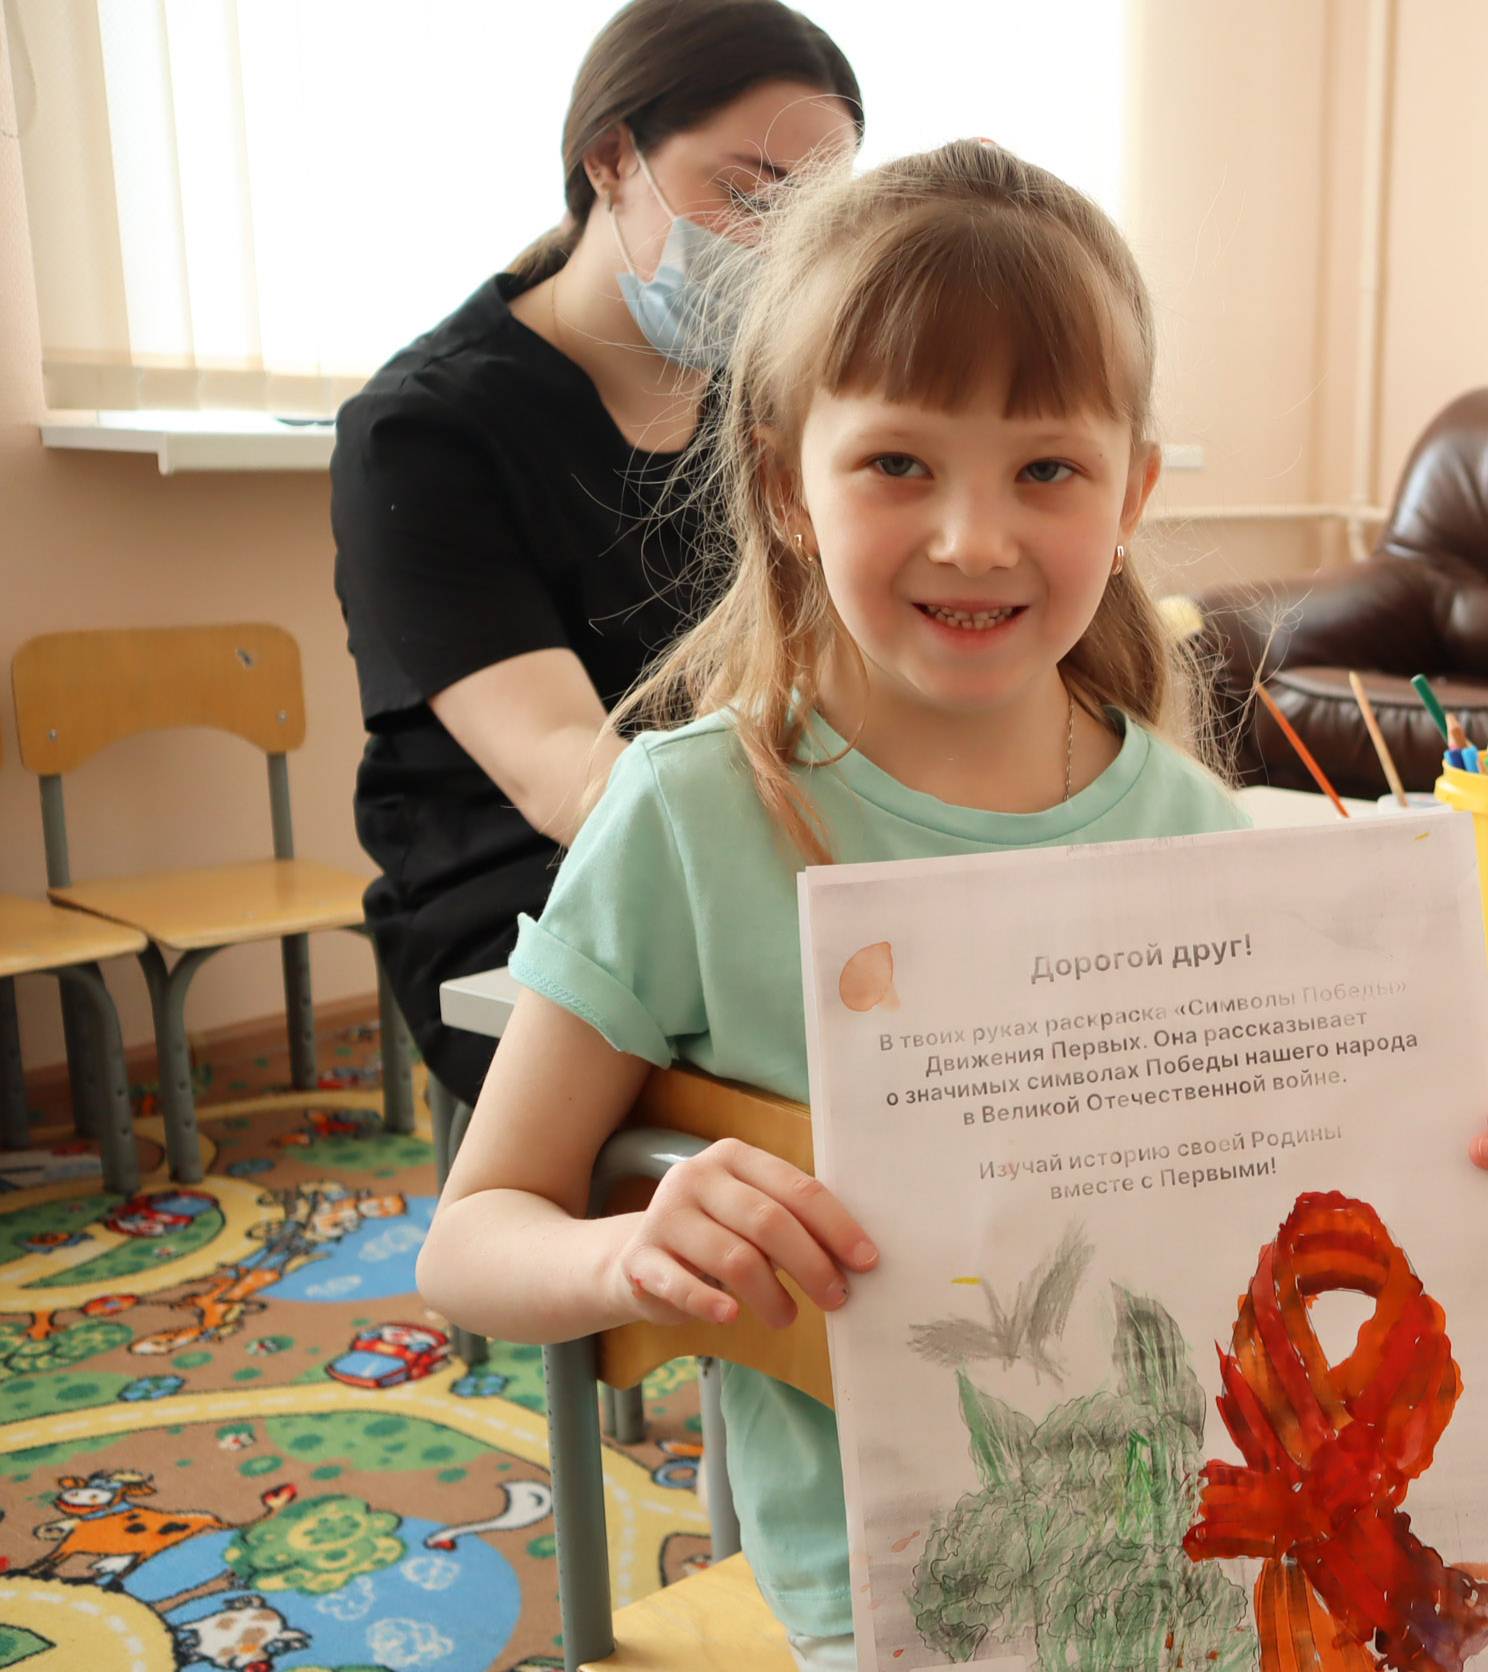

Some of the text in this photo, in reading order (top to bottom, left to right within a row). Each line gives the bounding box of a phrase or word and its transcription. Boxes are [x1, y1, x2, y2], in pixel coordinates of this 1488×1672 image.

[1031, 933, 1252, 984] Дорогой друг!
[879, 980, 1407, 1051] В твоих руках раскраска «Символы Победы»
[925, 1011, 1368, 1078] Движения Первых. Она рассказывает
[886, 1034, 1418, 1106] о значимых символах Победы нашего народа
[963, 1068, 1347, 1126] в Великой Отечественной войне.
[979, 1125, 1343, 1181] Изучай историю своей Родины
[1050, 1157, 1277, 1201] вместе с Первыми!
